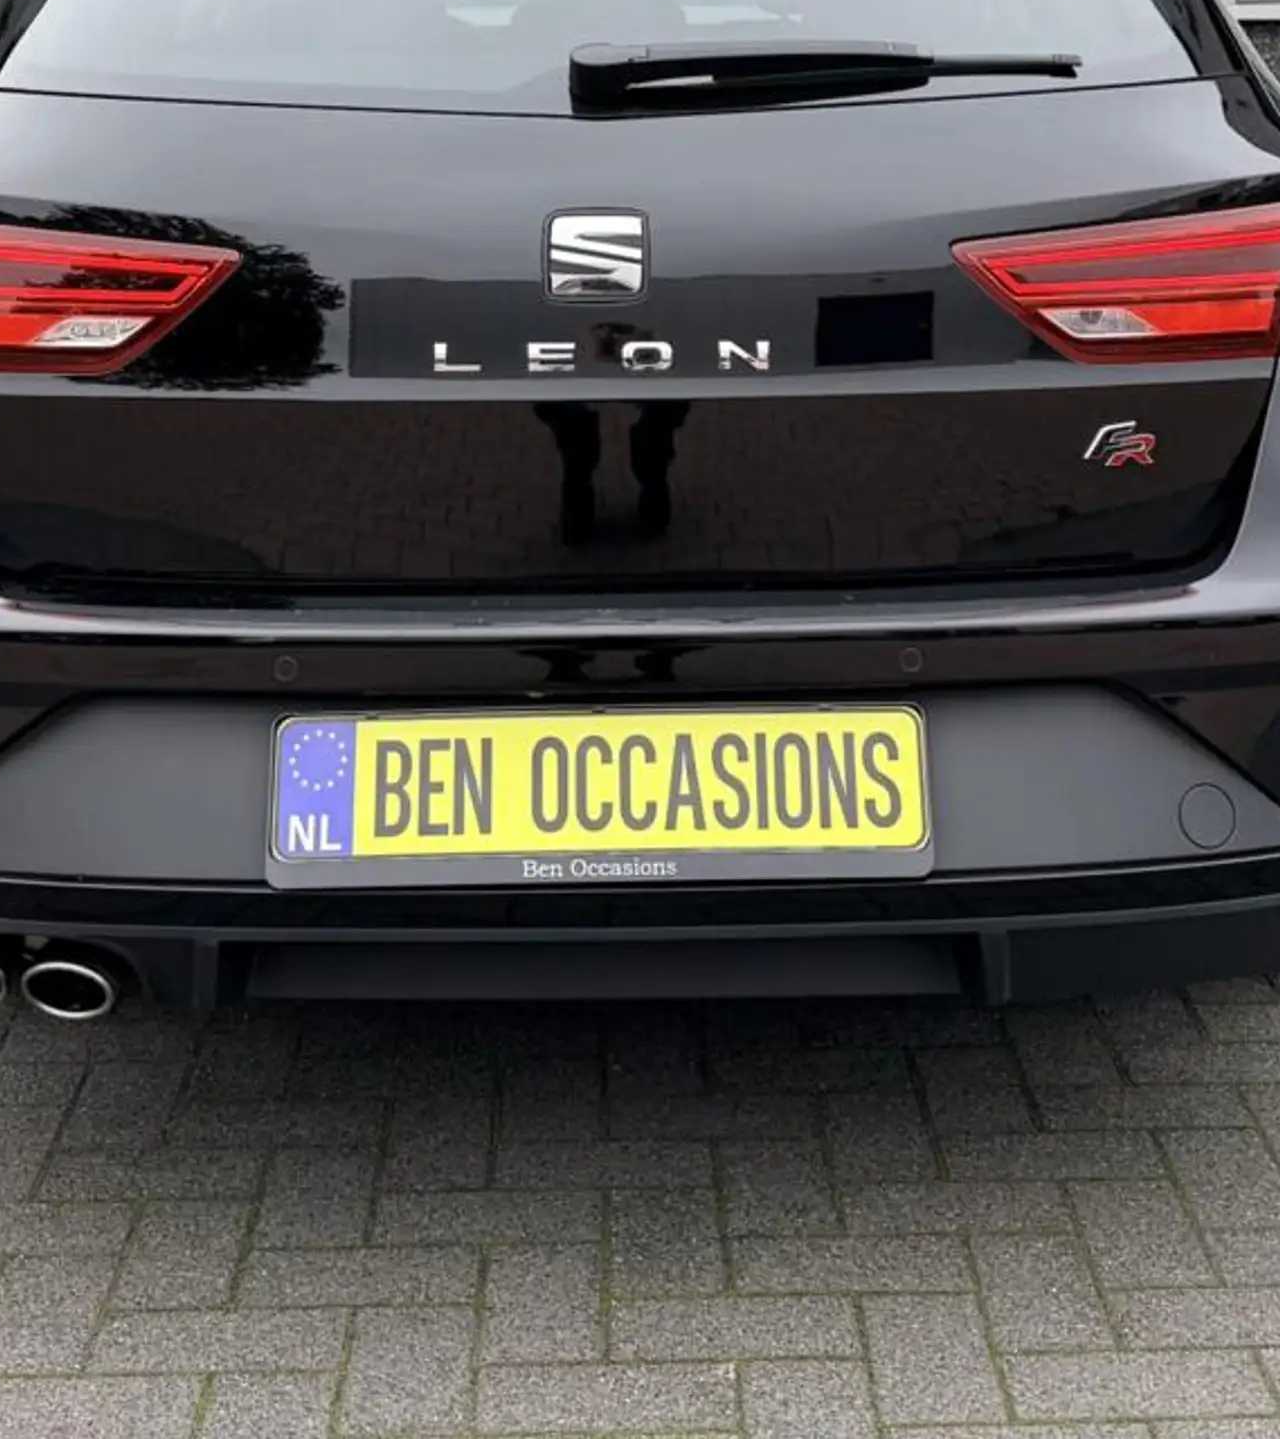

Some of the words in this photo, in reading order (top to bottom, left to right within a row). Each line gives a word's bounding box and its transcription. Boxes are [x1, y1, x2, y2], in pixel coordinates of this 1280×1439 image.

[432, 340, 770, 372] LEON
[1083, 420, 1156, 467] FR
[373, 737, 494, 838] BEN
[530, 731, 902, 832] OCCASIONS
[287, 813, 342, 852] NL
[522, 859, 564, 879] Ben
[569, 857, 677, 879] Occasions
